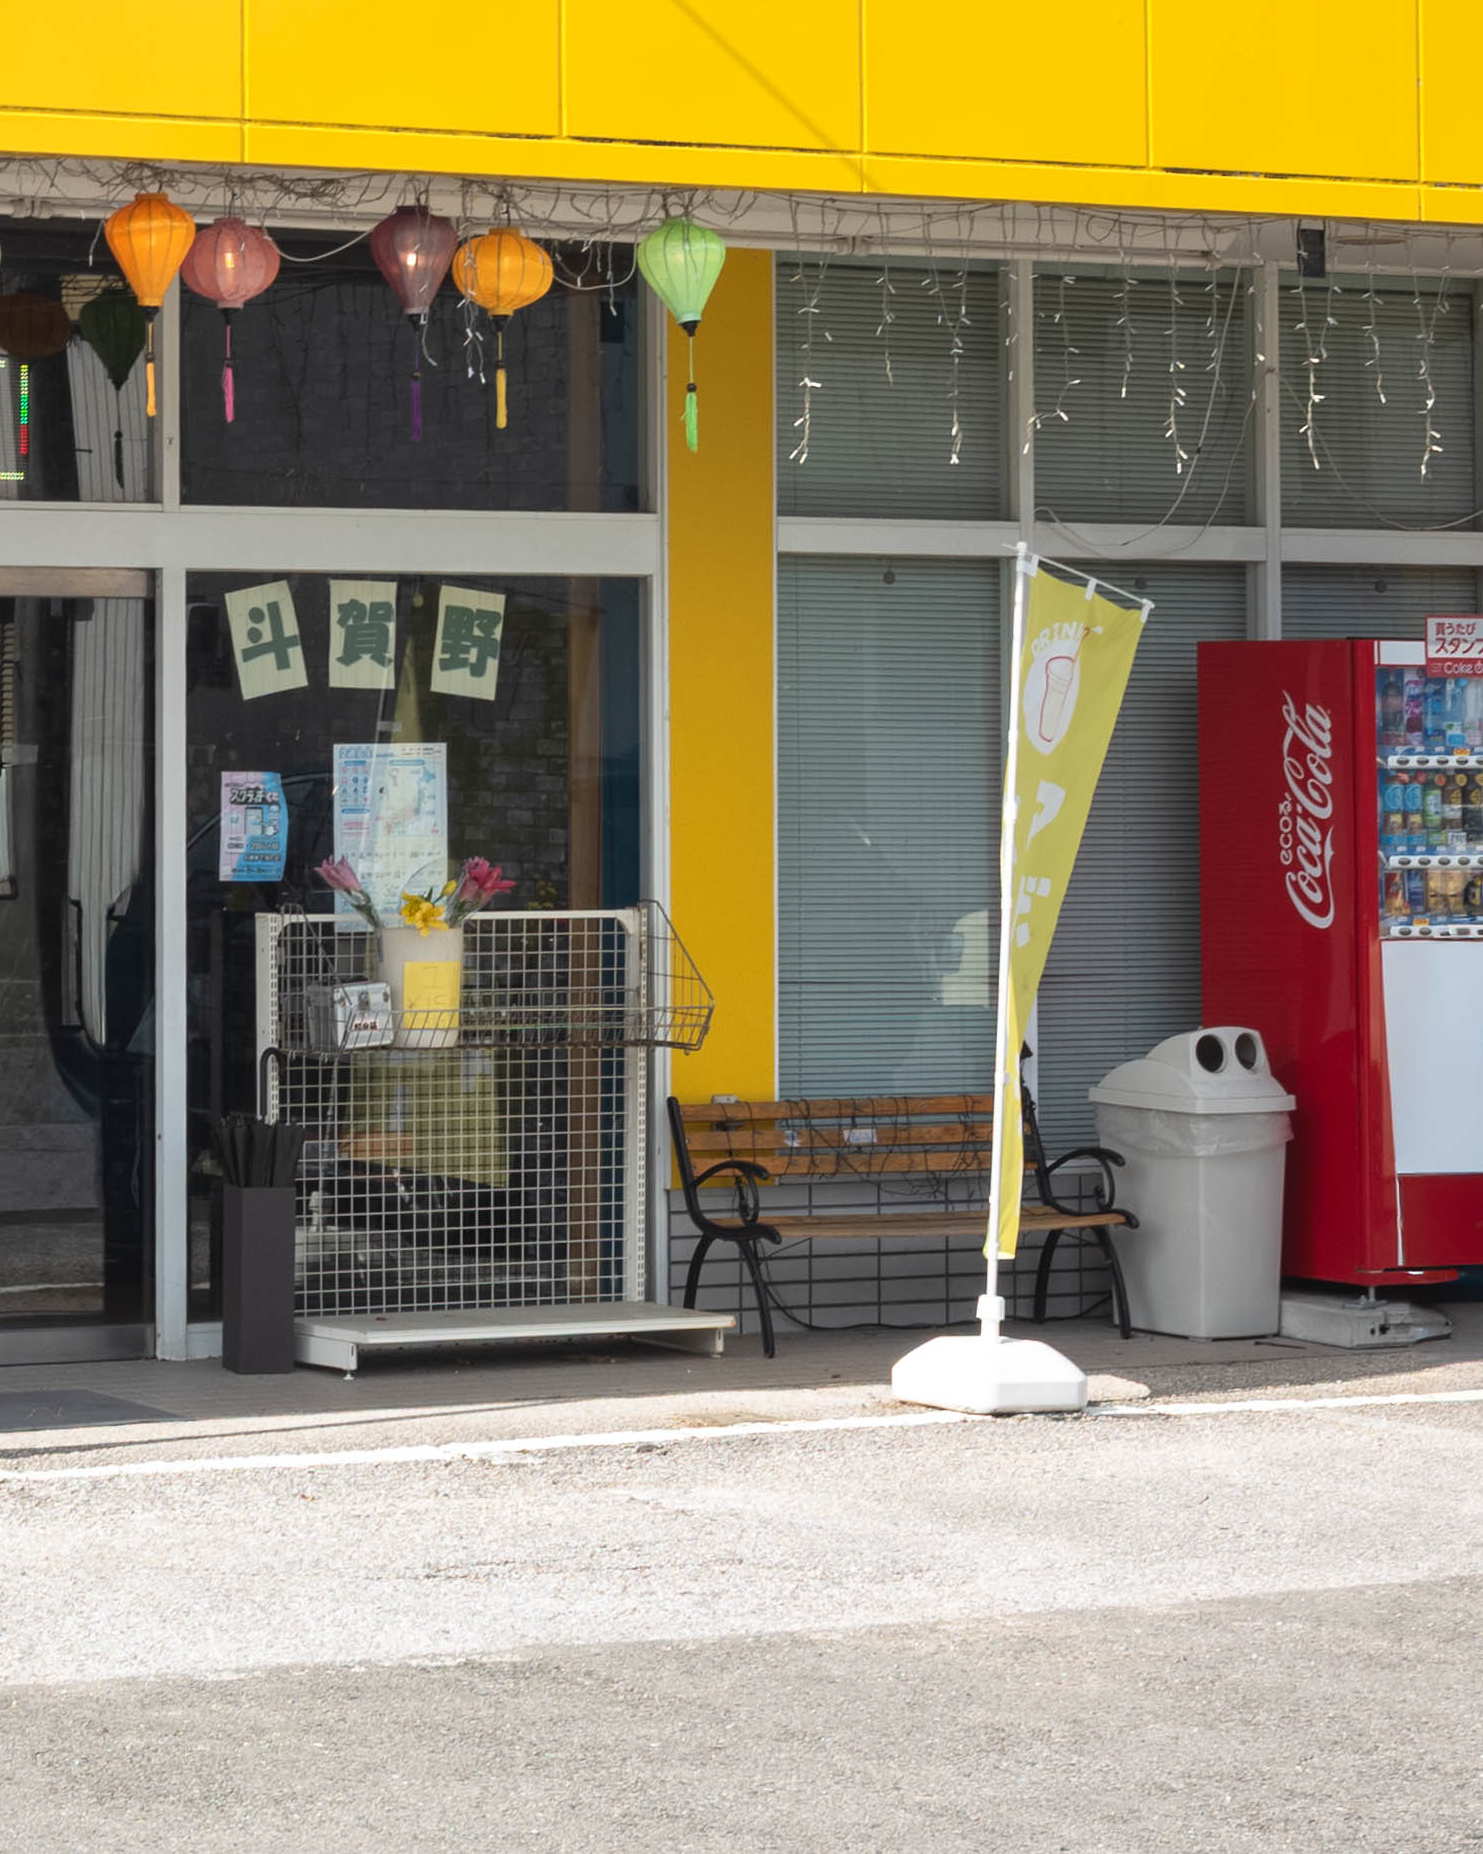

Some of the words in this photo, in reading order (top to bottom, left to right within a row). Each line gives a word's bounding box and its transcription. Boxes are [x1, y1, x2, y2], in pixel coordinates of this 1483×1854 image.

[1435, 622, 1476, 636] 買うたび
[1282, 690, 1335, 929] Coca-Cola
